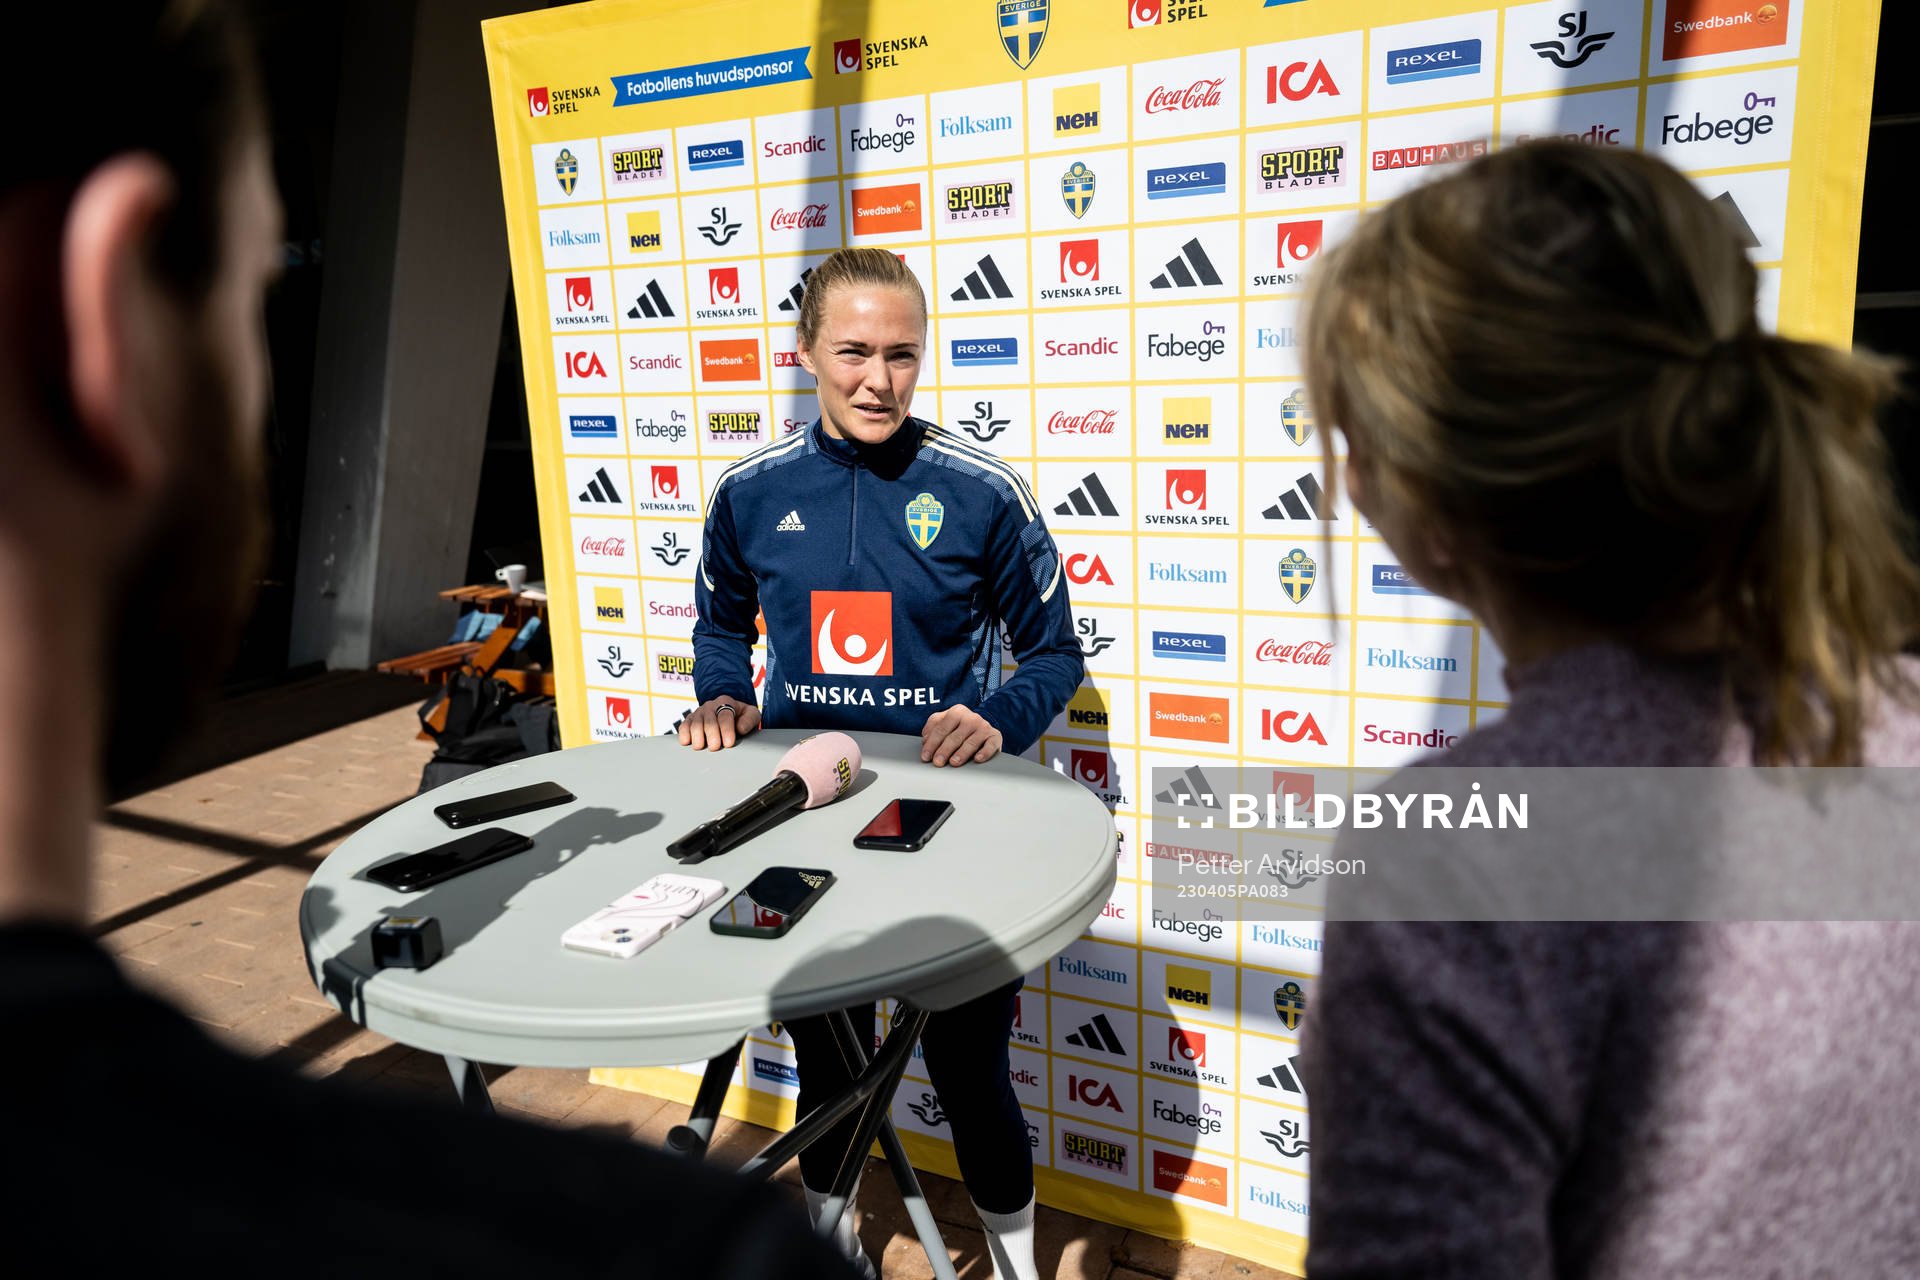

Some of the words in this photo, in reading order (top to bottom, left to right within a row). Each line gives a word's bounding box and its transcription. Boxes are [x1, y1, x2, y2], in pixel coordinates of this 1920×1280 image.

[1004, 1, 1041, 12] SVERIGE
[1168, 4, 1208, 22] SPEL
[1558, 10, 1587, 38] SJ
[1674, 11, 1752, 33] Swedbank
[865, 35, 928, 56] SVENSKA
[866, 53, 898, 70] SPEL
[627, 75, 694, 97] Fotbollens
[695, 60, 794, 88] huvudsponsor
[1266, 58, 1340, 104] ICA
[552, 85, 600, 102] SVENSKA
[553, 102, 578, 115] SPEL
[940, 112, 1012, 138] Folksam
[1662, 112, 1774, 145] Fabege
[764, 135, 826, 158] Scandic
[850, 128, 915, 154] Fabege
[613, 147, 664, 174] SPORT
[1262, 146, 1343, 181] SPORT
[1375, 142, 1484, 168] BAUHAUS
[617, 170, 664, 182] BLADET
[1265, 175, 1340, 190] BLADET
[948, 182, 1012, 211] SPORT
[711, 207, 726, 225] SJ
[857, 204, 902, 217] Swedbank
[951, 208, 1010, 220] BLADET
[548, 228, 600, 248] Folksam
[1254, 274, 1301, 286] SVENS
[1041, 286, 1091, 299] SVENSKA
[1095, 285, 1122, 297] SPEL
[556, 315, 590, 325] SVENSKA
[592, 315, 610, 324] SPEL
[696, 309, 734, 320] SVENSKA
[738, 307, 758, 318] SPEL
[1045, 337, 1118, 356] Scandic
[1148, 334, 1224, 362] Fabege
[565, 351, 607, 378] ICA
[630, 354, 682, 370] Scandic
[704, 356, 742, 366] Swedbank
[975, 402, 992, 420] SJ
[636, 419, 686, 442] Fabege
[708, 412, 760, 433] SPORT
[640, 502, 675, 512] SVENSKA
[678, 504, 696, 512] SPEL
[776, 522, 805, 532] adidas
[1145, 515, 1198, 526] SVENSKA
[1202, 516, 1230, 526] SPEL
[663, 532, 677, 548] SJ
[1059, 553, 1114, 586] CA
[1149, 562, 1227, 584] Folksam
[650, 601, 696, 618] Scandi
[1078, 618, 1097, 636] SJ
[608, 646, 621, 661] SJ
[1368, 648, 1458, 672] Folksam
[658, 655, 694, 676] SPOR
[662, 674, 690, 682] BLAD
[884, 687, 940, 706] SPEL
[1155, 710, 1206, 724] Swedbank
[596, 729, 628, 738] SVENSKA
[1261, 708, 1328, 746] ICA
[1104, 794, 1128, 804] SPEL
[1152, 910, 1222, 942] Fabege
[1058, 956, 1127, 984] Folksam
[1018, 1032, 1040, 1044] SPEL
[1150, 1061, 1197, 1079] SVENSKA
[1202, 1072, 1228, 1085] SPEL
[1069, 1075, 1124, 1113] ICA
[1153, 1100, 1222, 1134] Fabege
[1279, 1120, 1299, 1139] SJ
[1065, 1133, 1126, 1165] SPORT
[1067, 1153, 1124, 1172] BLADET
[1159, 1167, 1206, 1186] Swedbank
[1250, 1186, 1312, 1216] Folksa
